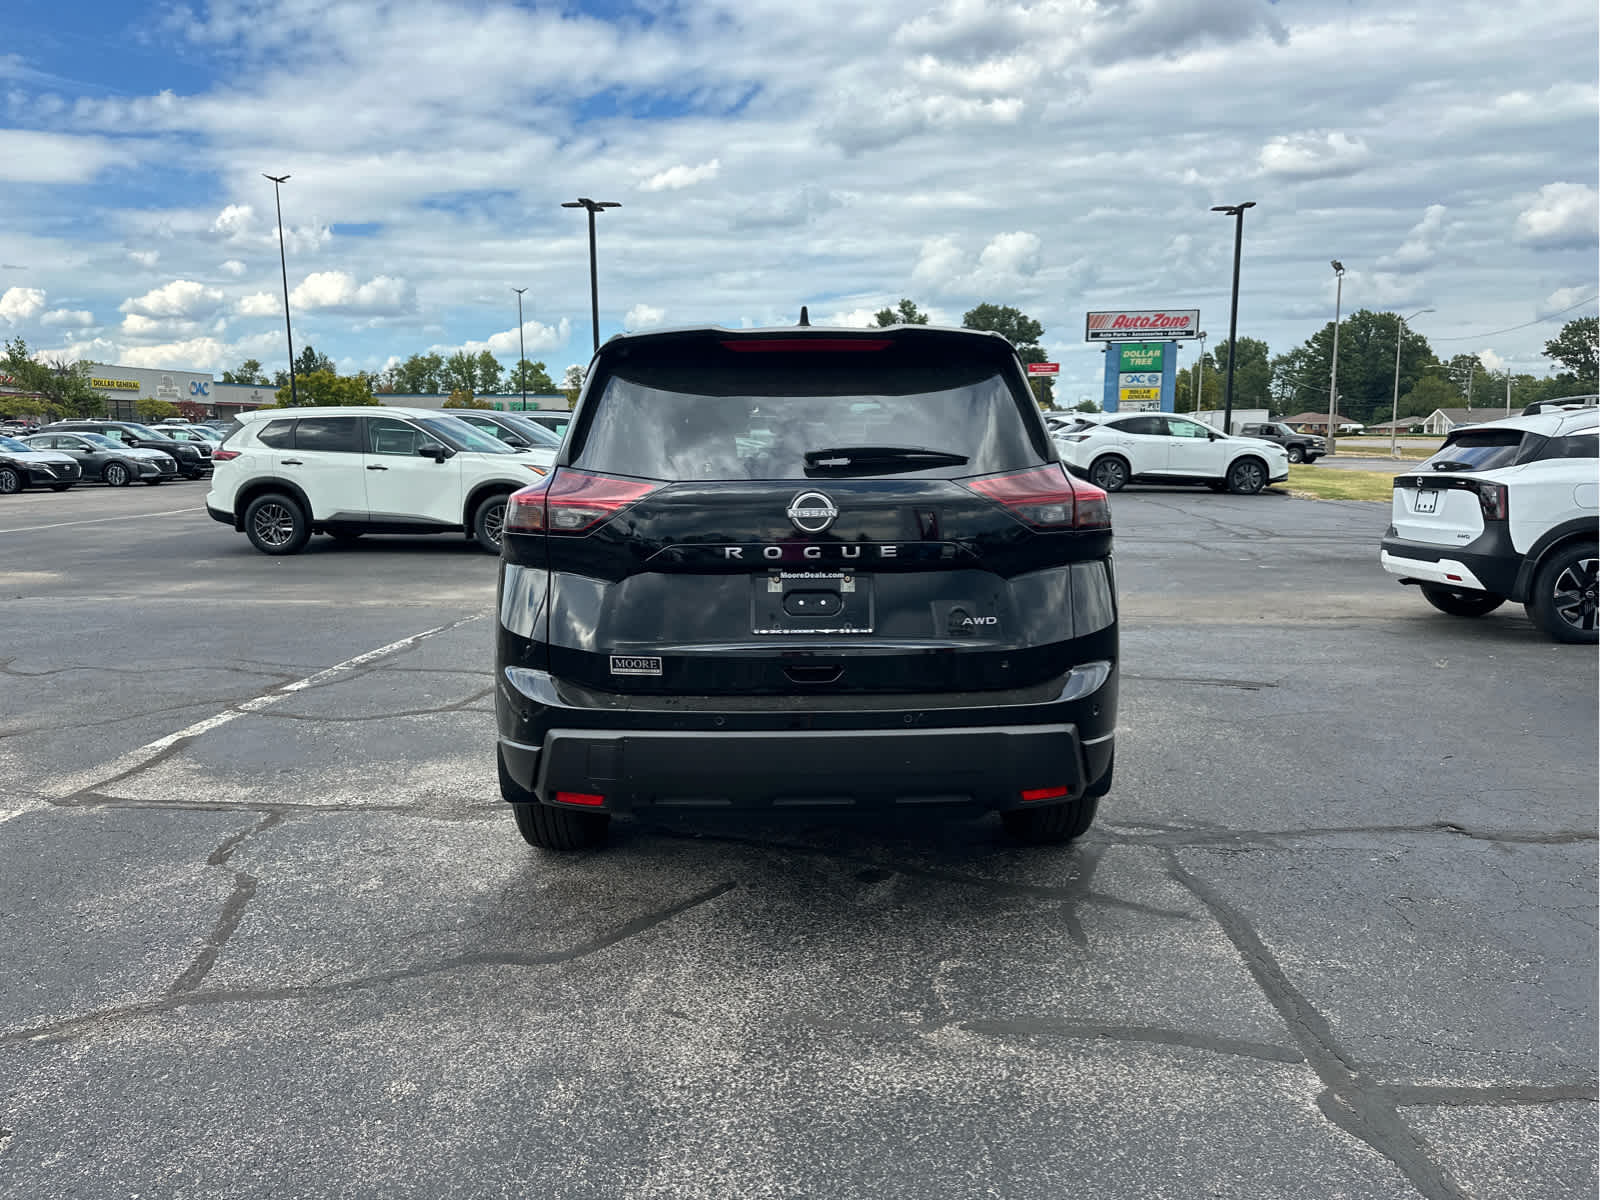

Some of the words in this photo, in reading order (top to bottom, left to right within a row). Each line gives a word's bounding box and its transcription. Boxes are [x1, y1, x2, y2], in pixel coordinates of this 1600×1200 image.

[1112, 313, 1190, 328] AutoZone
[1123, 350, 1160, 358] DOLLAR
[93, 379, 115, 388] DOLLAR
[116, 381, 140, 389] GENERAL
[788, 509, 838, 518] NISSAN
[724, 545, 897, 559] ROGUE
[780, 571, 845, 579] MooreDeals.com
[961, 616, 998, 625] AWD
[615, 659, 658, 669] MOORE
